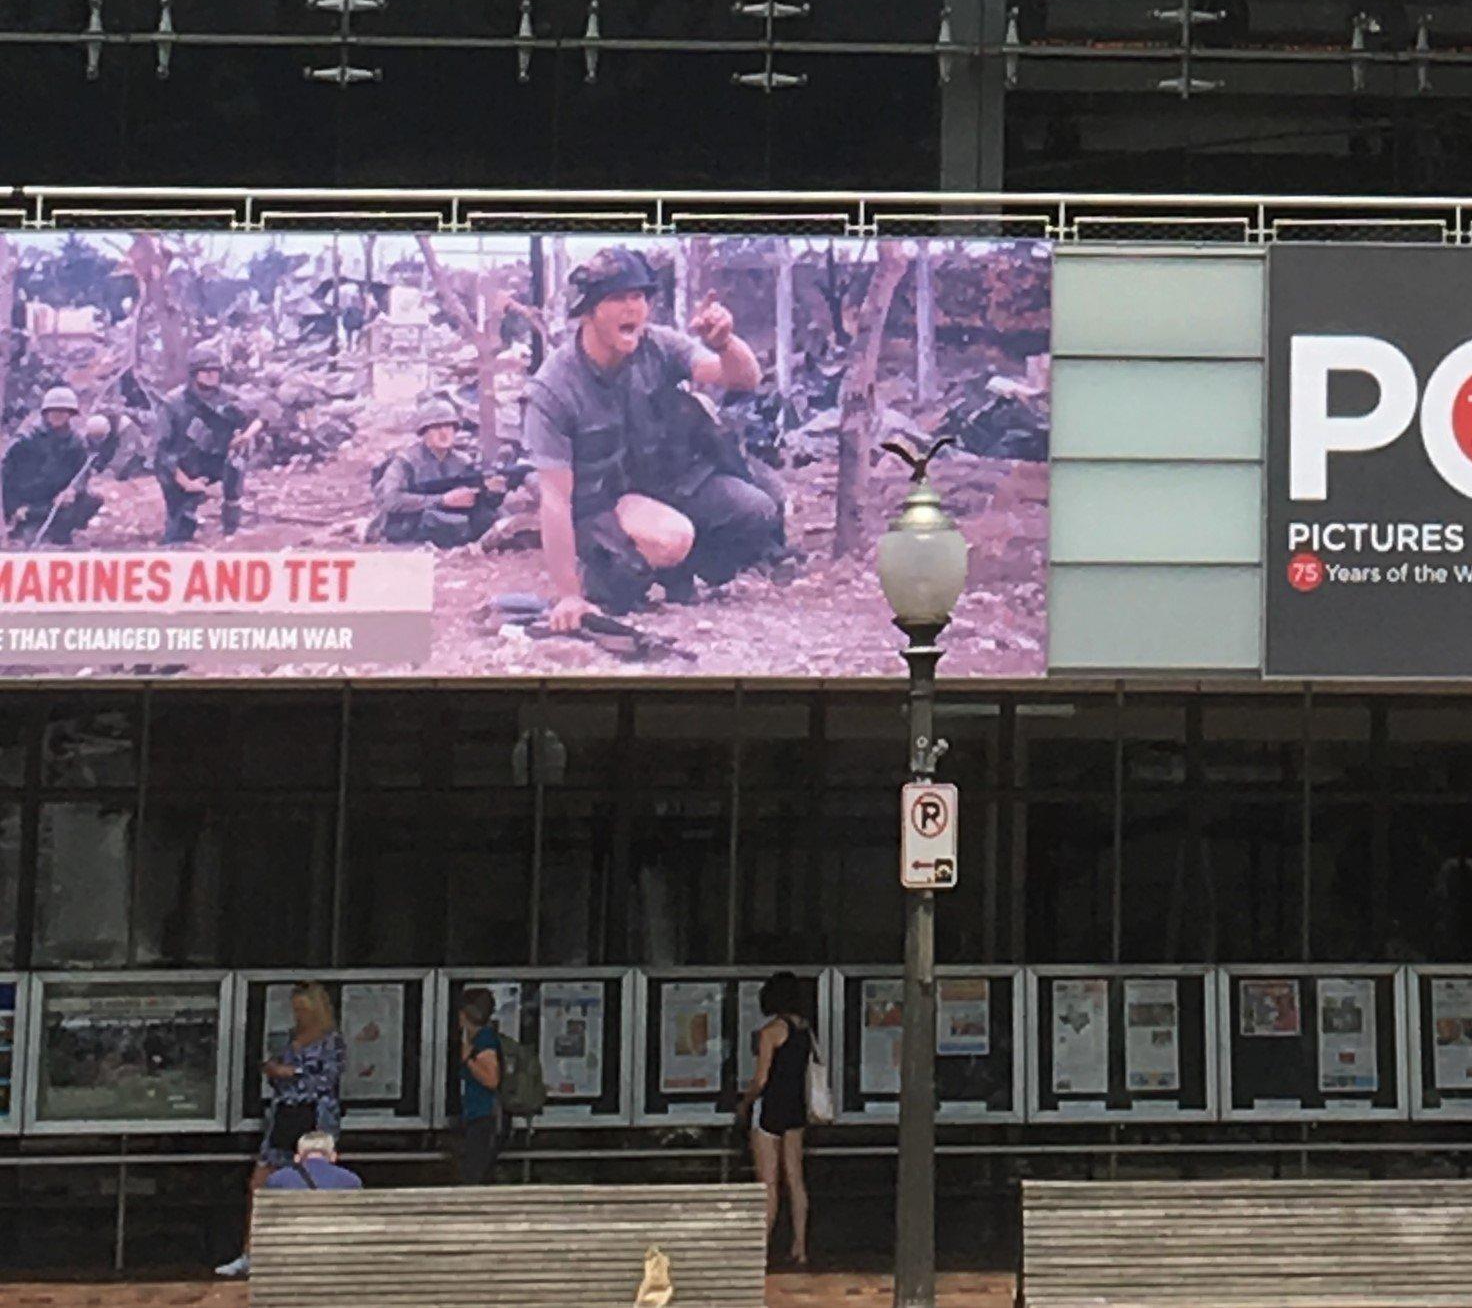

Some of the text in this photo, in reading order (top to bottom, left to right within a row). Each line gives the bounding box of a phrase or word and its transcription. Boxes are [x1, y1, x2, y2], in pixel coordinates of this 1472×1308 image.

[1288, 522, 1465, 552] PICTURES
[183, 559, 272, 603] AND
[284, 559, 356, 602] TET
[1293, 563, 1318, 582] 75
[1325, 564, 1382, 583] Years
[1386, 563, 1409, 583] of
[1414, 564, 1448, 583] the
[9, 628, 61, 651] THAT
[64, 628, 161, 651] CHANGED
[166, 627, 203, 651] THE
[208, 627, 298, 651] VIETNAM
[303, 627, 353, 651] WAR
